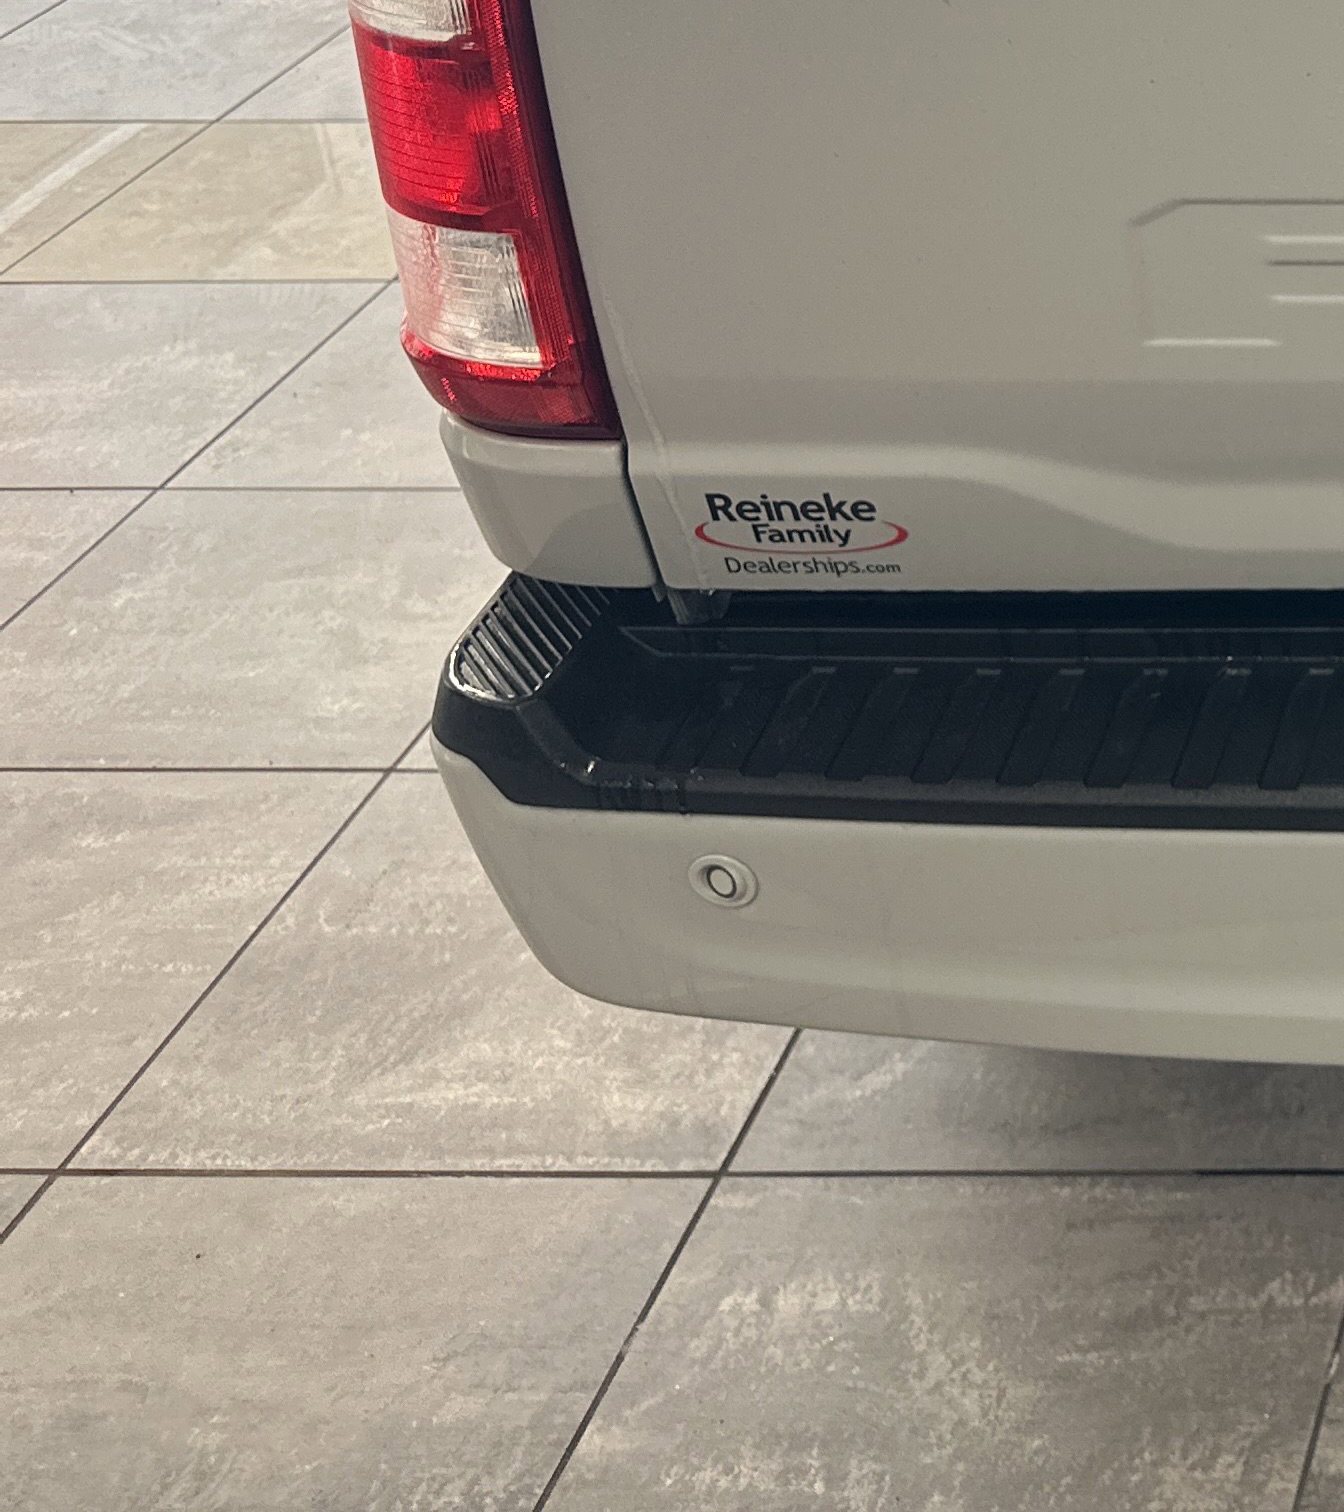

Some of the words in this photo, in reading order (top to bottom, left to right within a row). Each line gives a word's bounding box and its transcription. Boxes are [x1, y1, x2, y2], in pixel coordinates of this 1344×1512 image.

[704, 492, 877, 522] Reineke
[751, 523, 852, 548] Family
[724, 556, 902, 577] Dealerships.com
